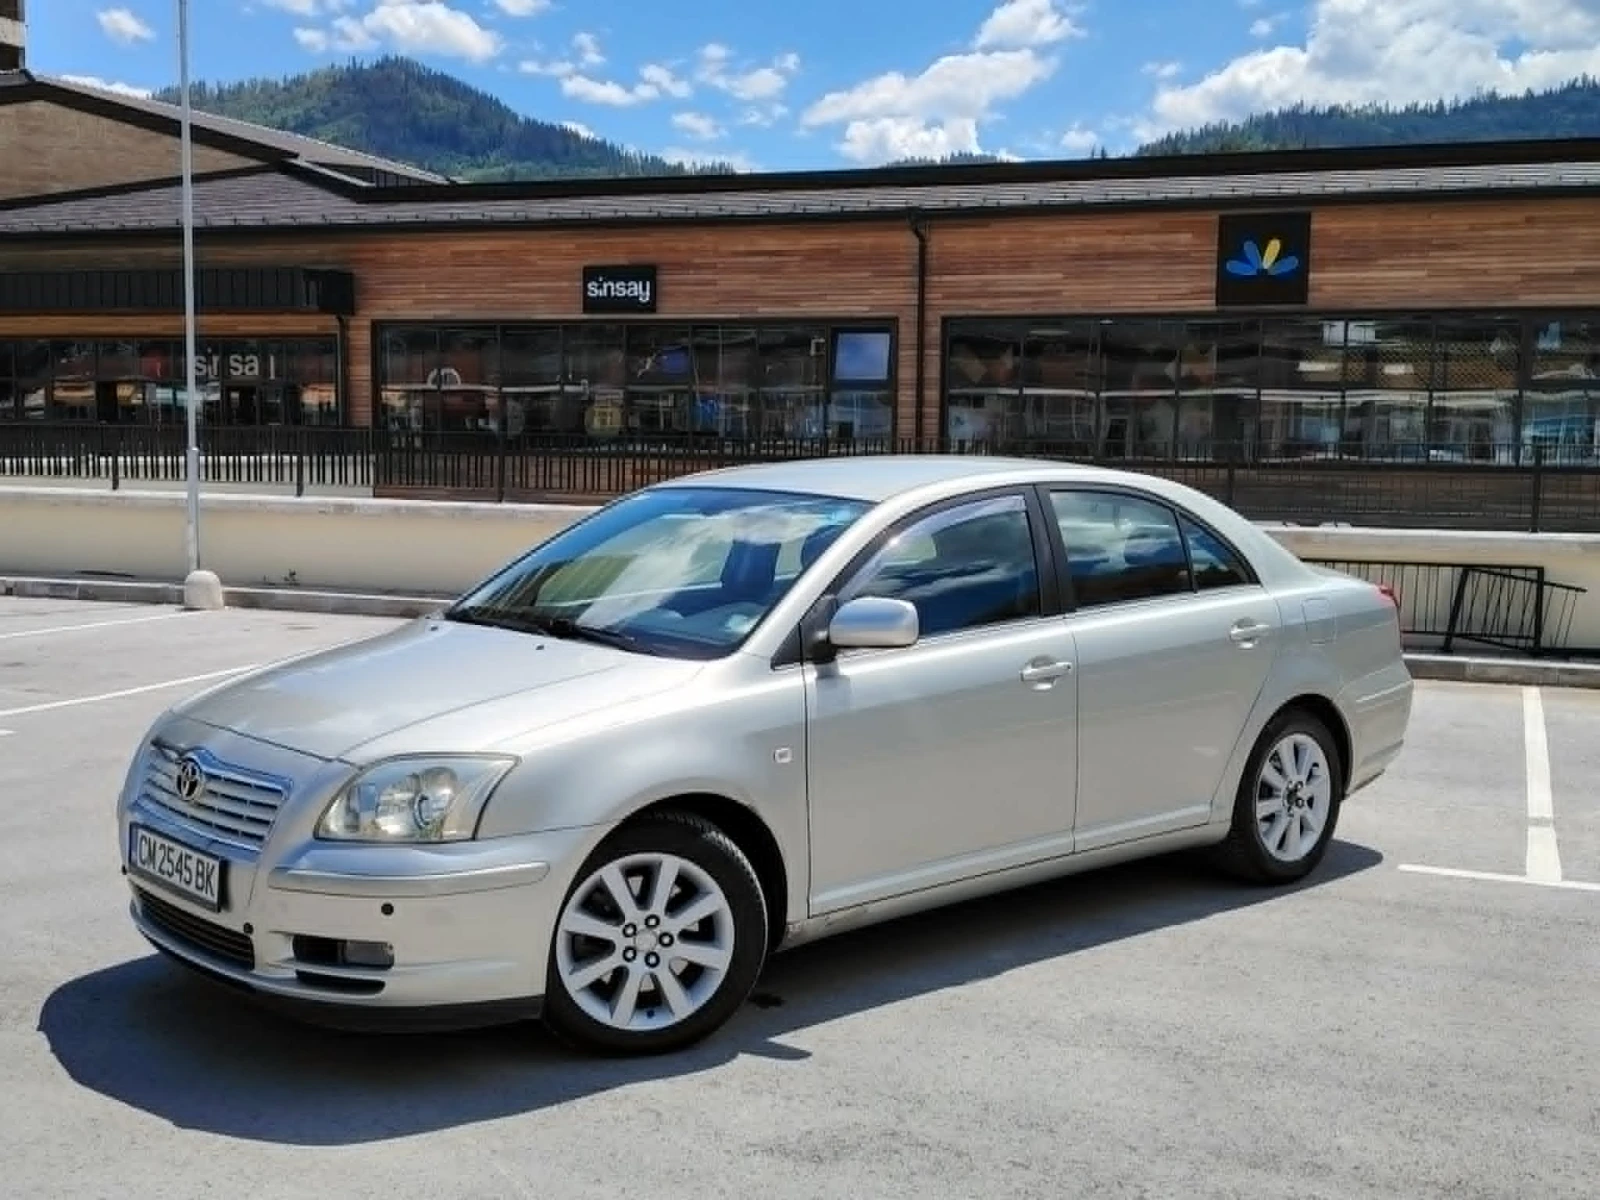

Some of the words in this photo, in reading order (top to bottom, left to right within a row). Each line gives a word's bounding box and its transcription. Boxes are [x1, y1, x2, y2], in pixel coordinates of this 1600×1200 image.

[587, 276, 651, 303] sinsay
[139, 835, 156, 870] CM
[159, 844, 192, 885] 2545
[195, 858, 215, 897] BK
